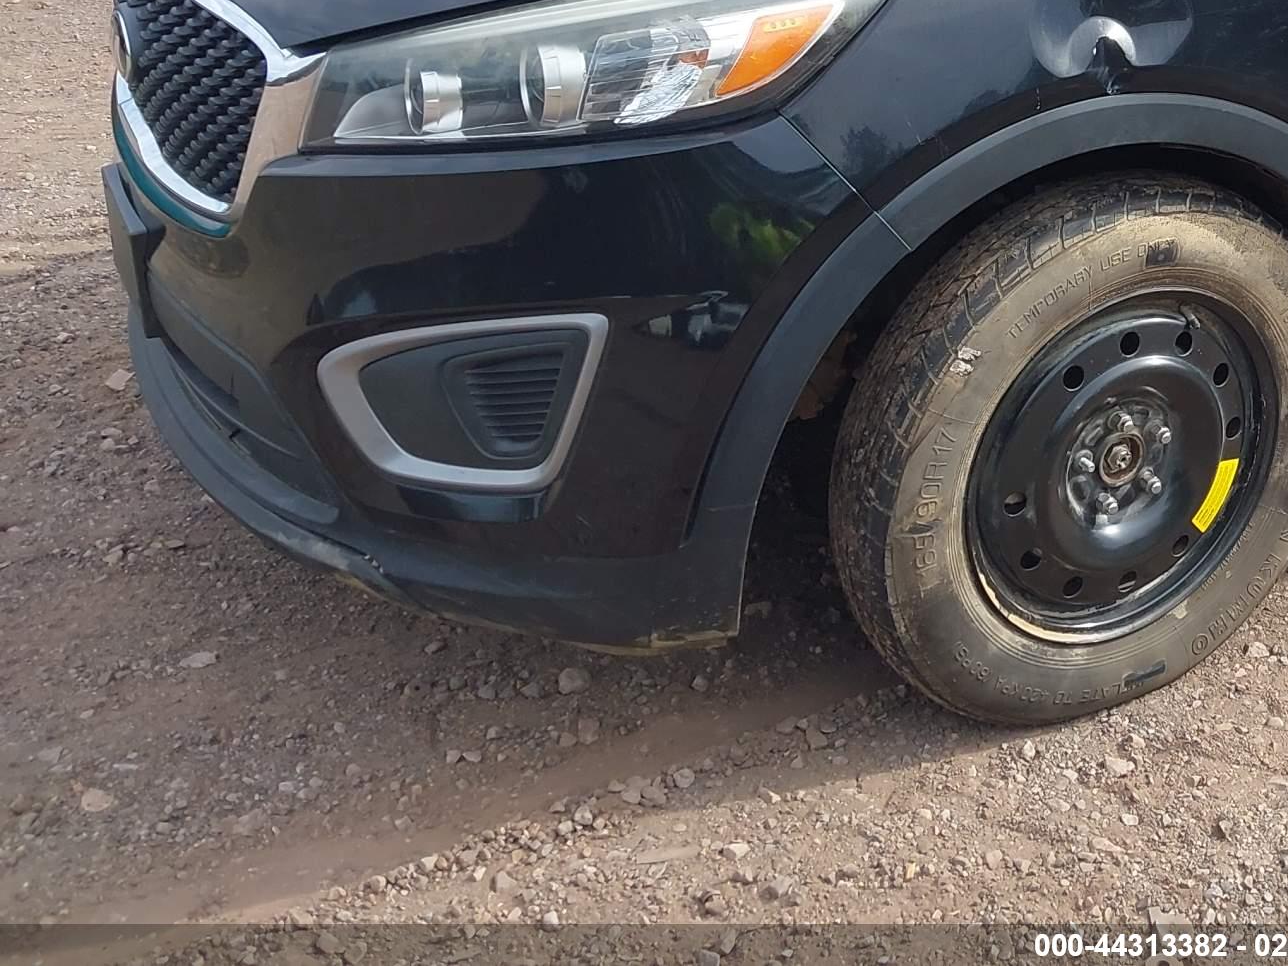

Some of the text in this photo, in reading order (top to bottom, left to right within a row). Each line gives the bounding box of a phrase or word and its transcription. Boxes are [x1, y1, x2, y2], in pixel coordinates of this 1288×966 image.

[1007, 265, 1093, 339] TEMPORARY
[1100, 246, 1132, 272] USE
[1191, 553, 1281, 656] KUMHO
